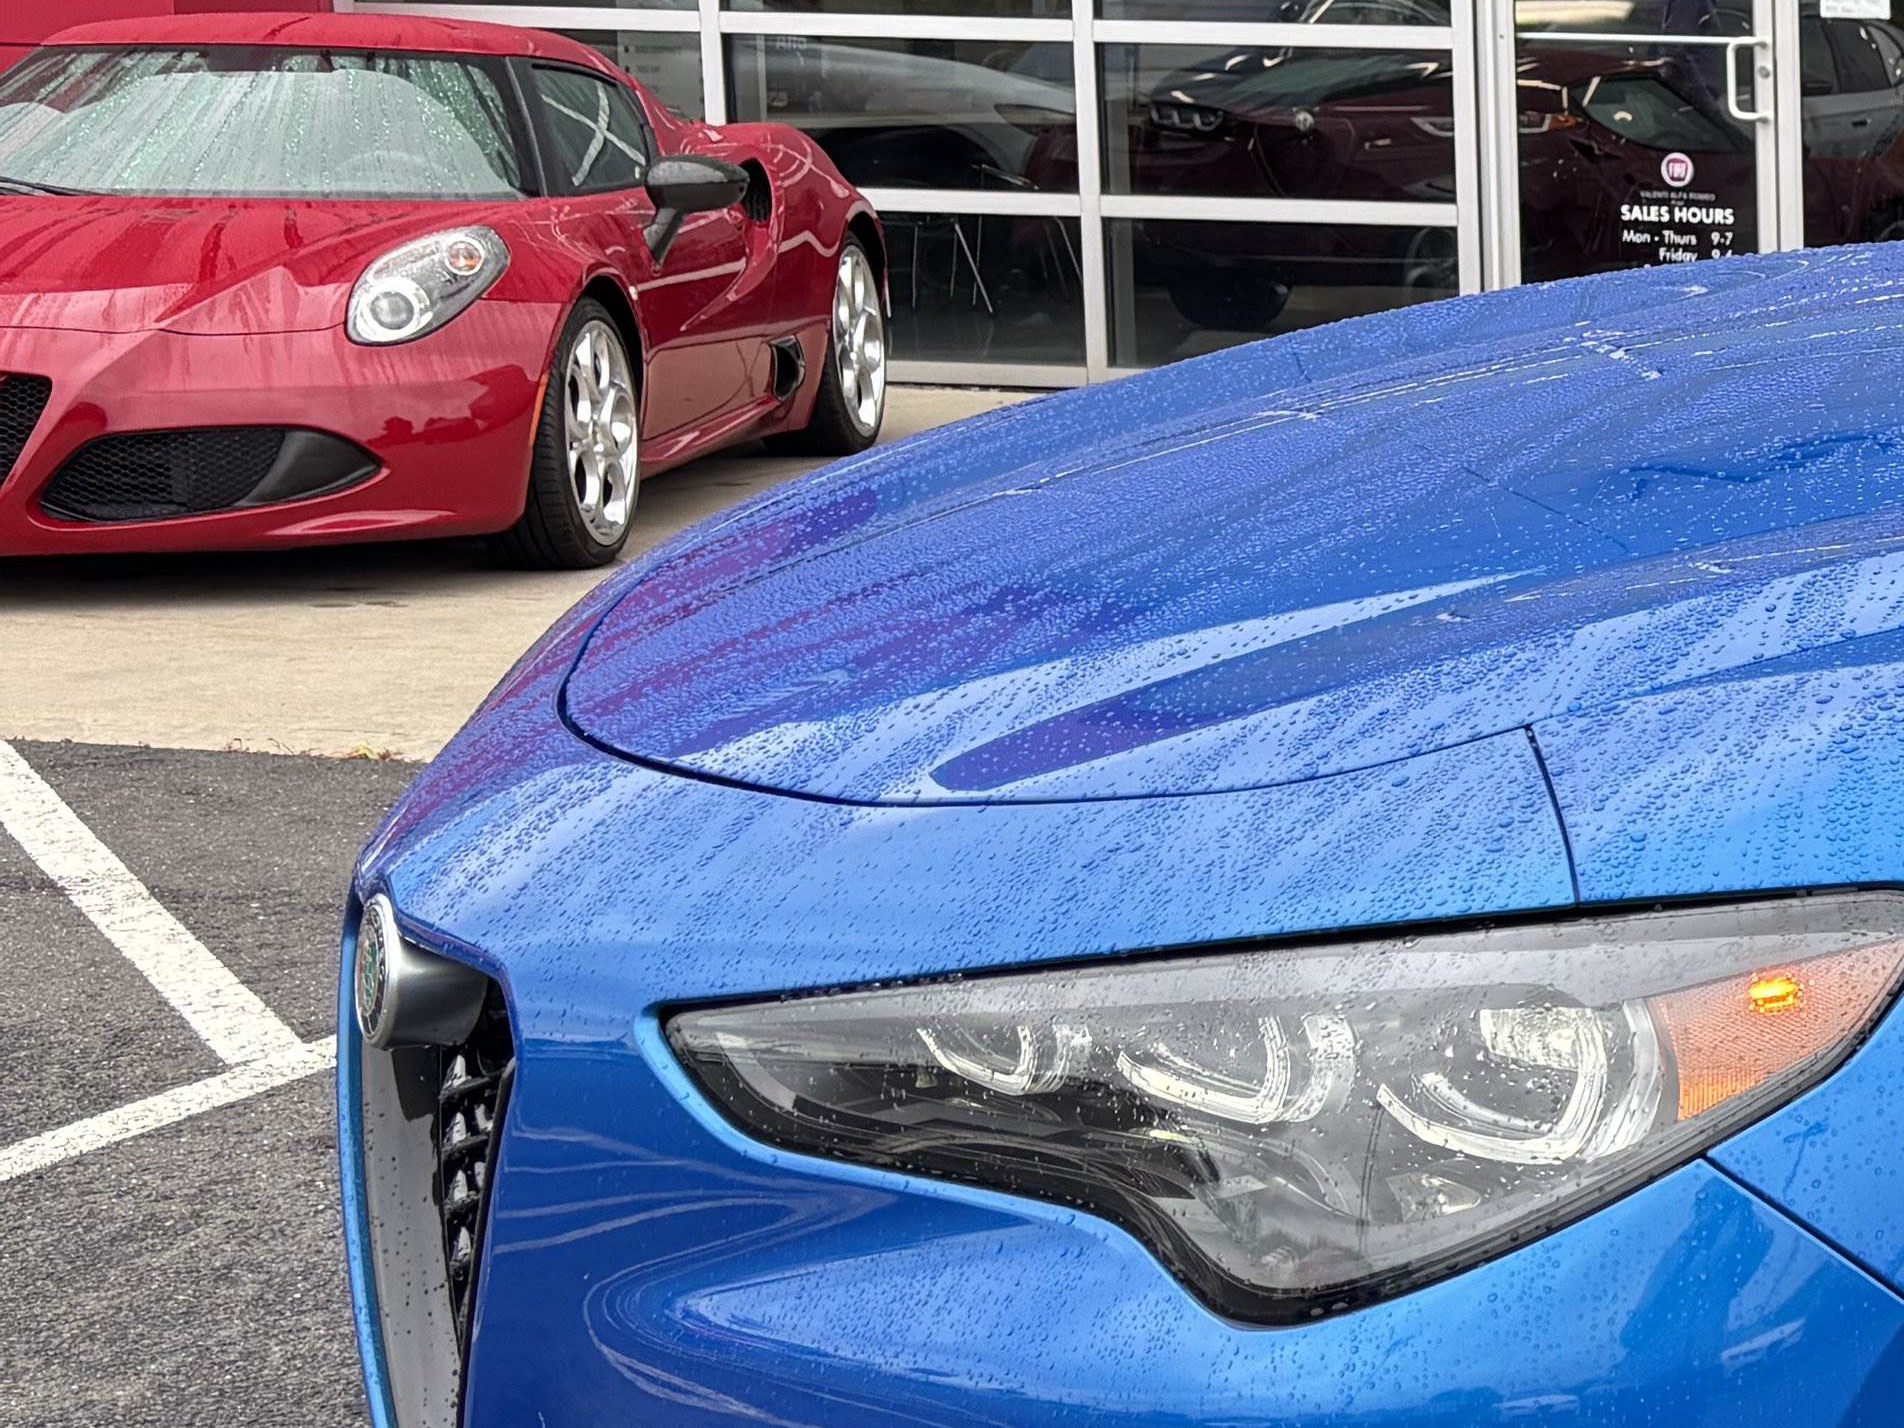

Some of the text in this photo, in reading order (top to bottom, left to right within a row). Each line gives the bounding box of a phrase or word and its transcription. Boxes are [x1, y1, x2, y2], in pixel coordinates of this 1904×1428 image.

[1620, 204, 1735, 225] SALES HOURS
[1622, 229, 1651, 244] Mon
[1661, 229, 1698, 245] Thurs
[1659, 247, 1698, 263] Friday
